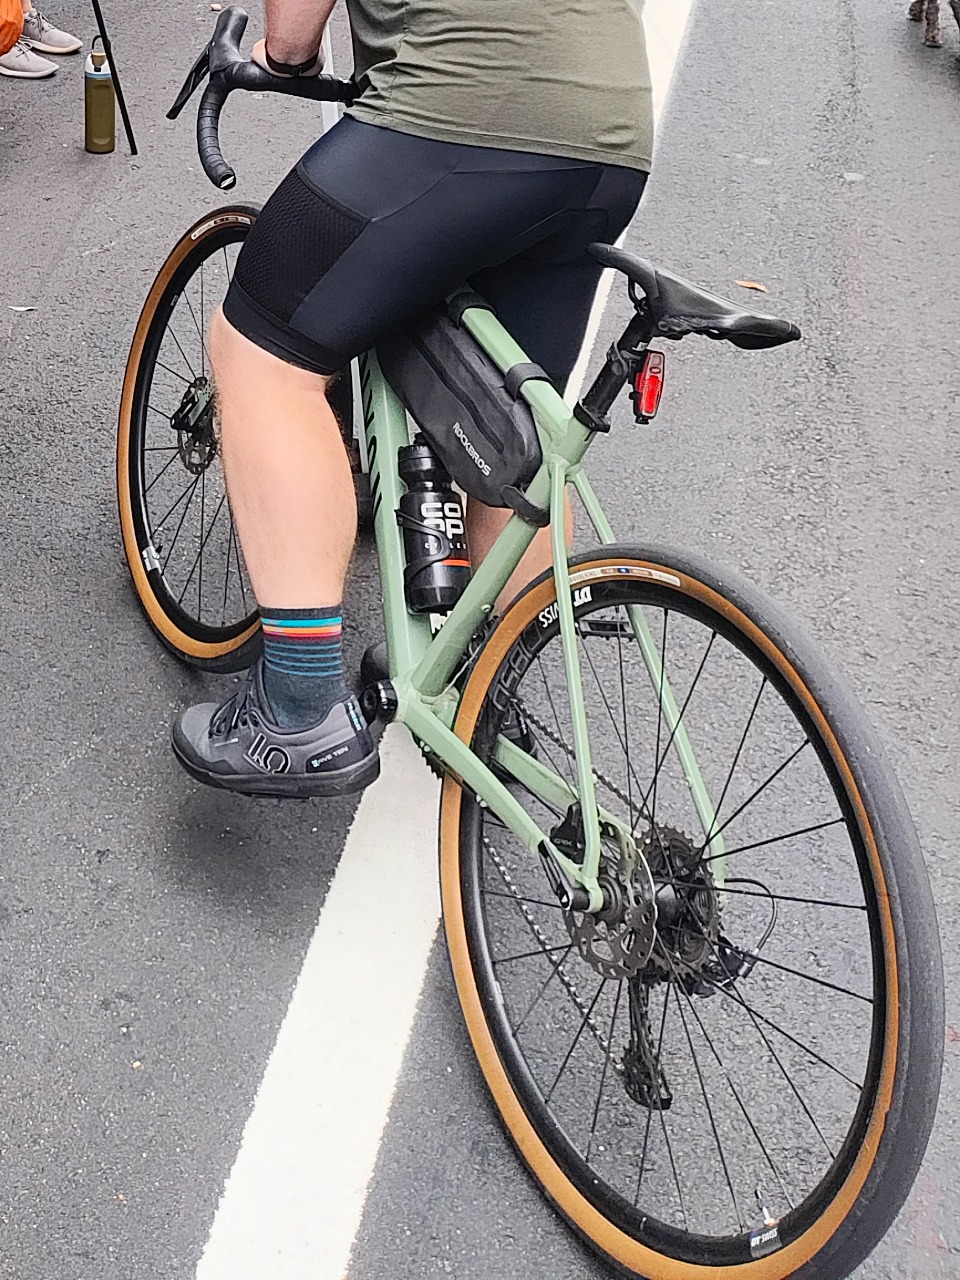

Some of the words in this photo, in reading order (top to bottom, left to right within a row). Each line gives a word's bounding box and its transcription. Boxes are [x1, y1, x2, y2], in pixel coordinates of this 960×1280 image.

[452, 422, 492, 477] ROCKBROS
[421, 502, 462, 519] CO
[574, 586, 592, 607] DT
